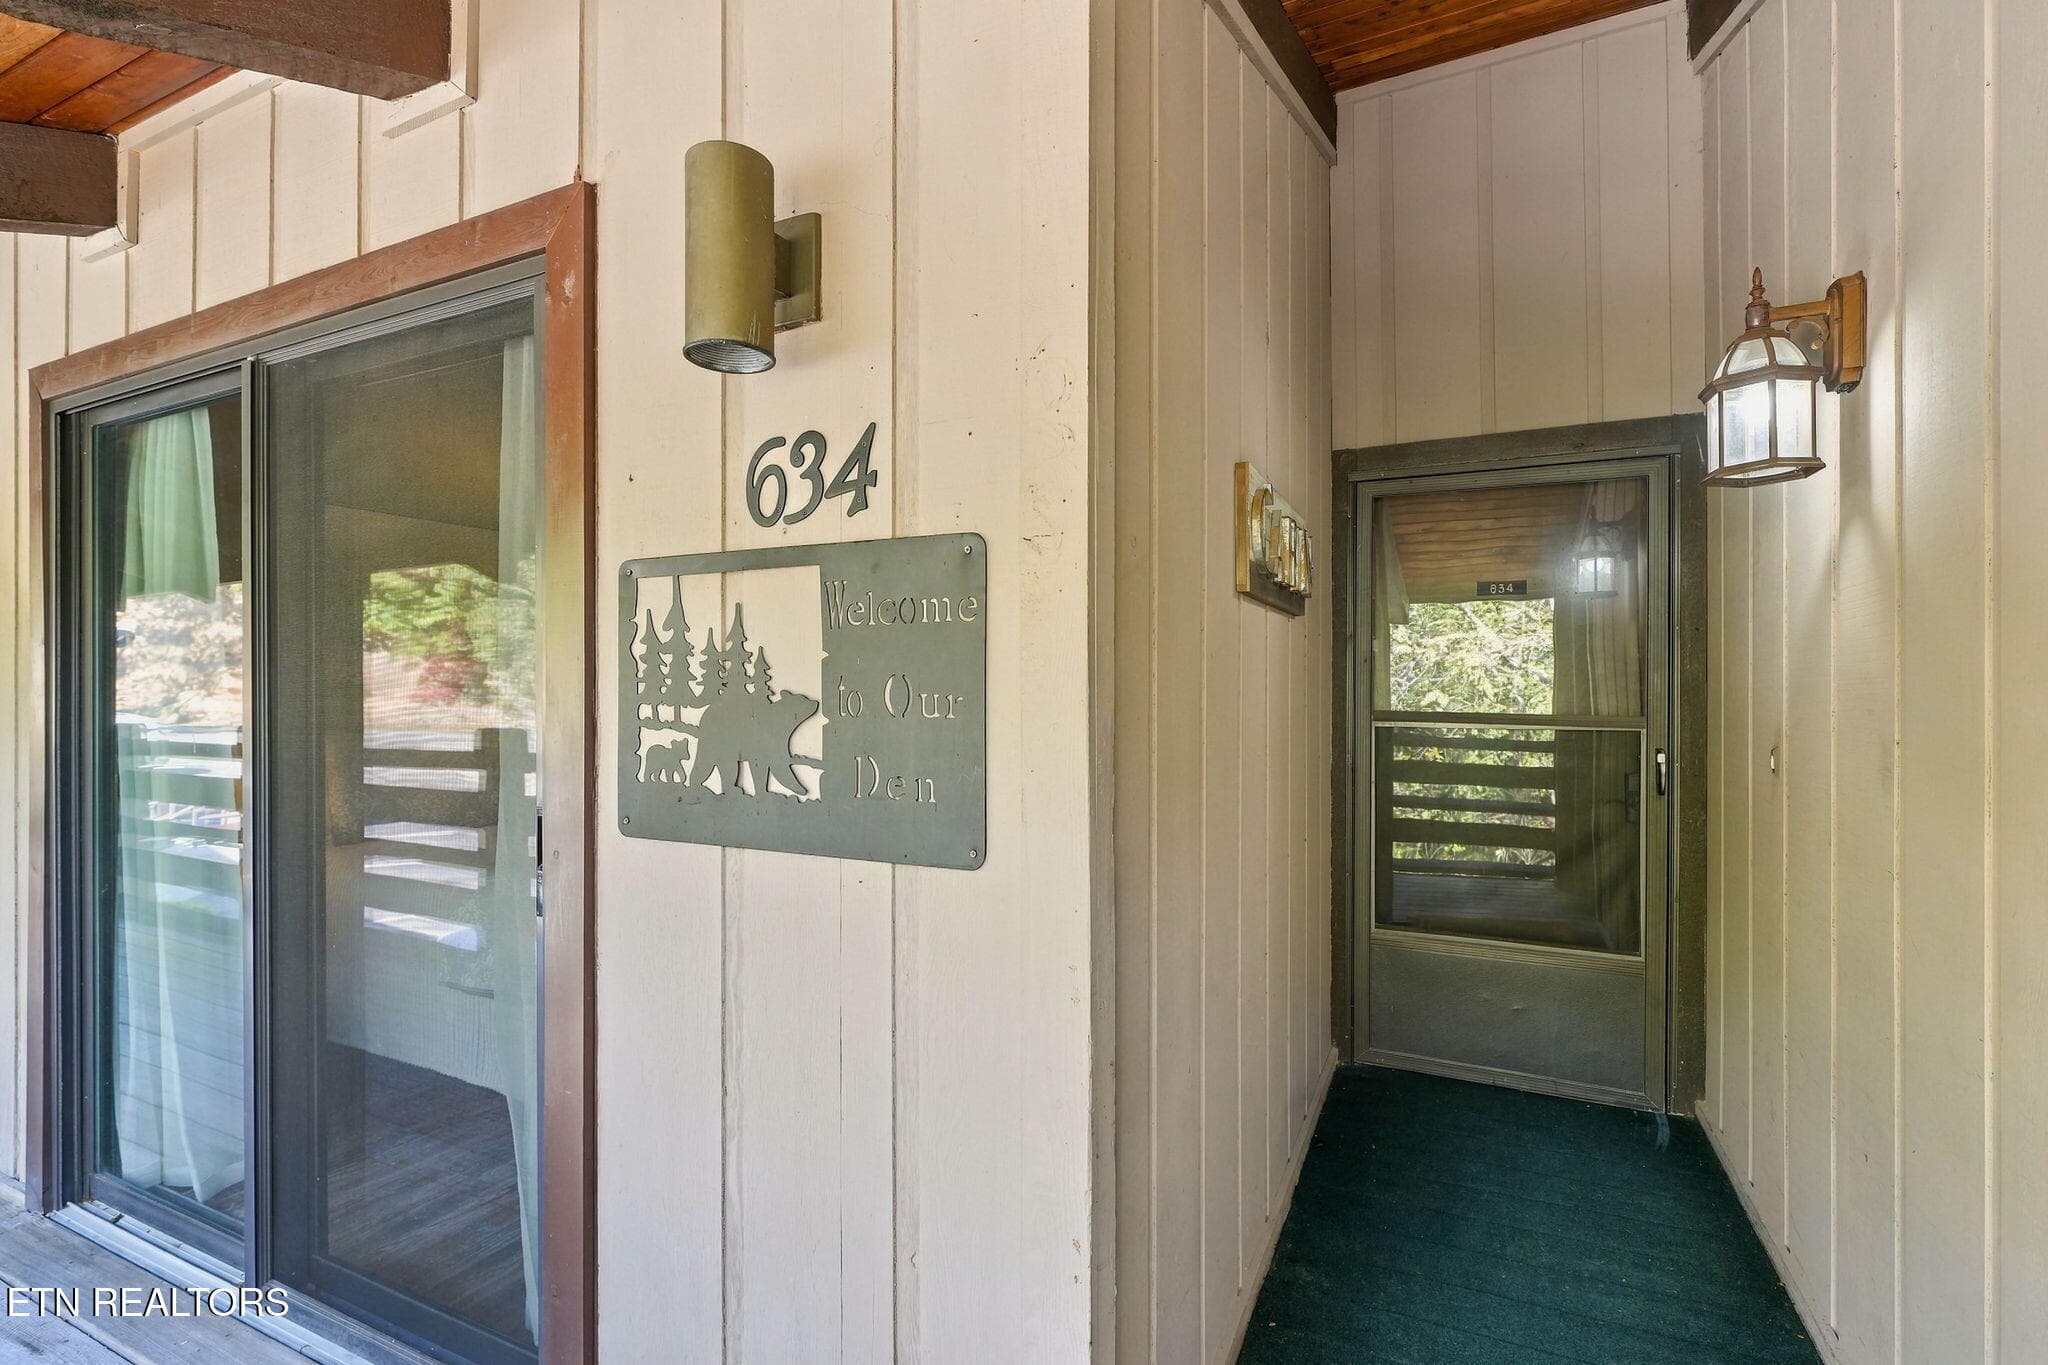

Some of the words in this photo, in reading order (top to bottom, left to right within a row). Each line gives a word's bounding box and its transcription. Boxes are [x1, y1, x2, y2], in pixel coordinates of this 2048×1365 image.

[745, 421, 878, 528] 634
[823, 579, 978, 630] Welcome
[837, 674, 864, 718] to
[883, 673, 964, 719] Our
[854, 754, 936, 803] Den
